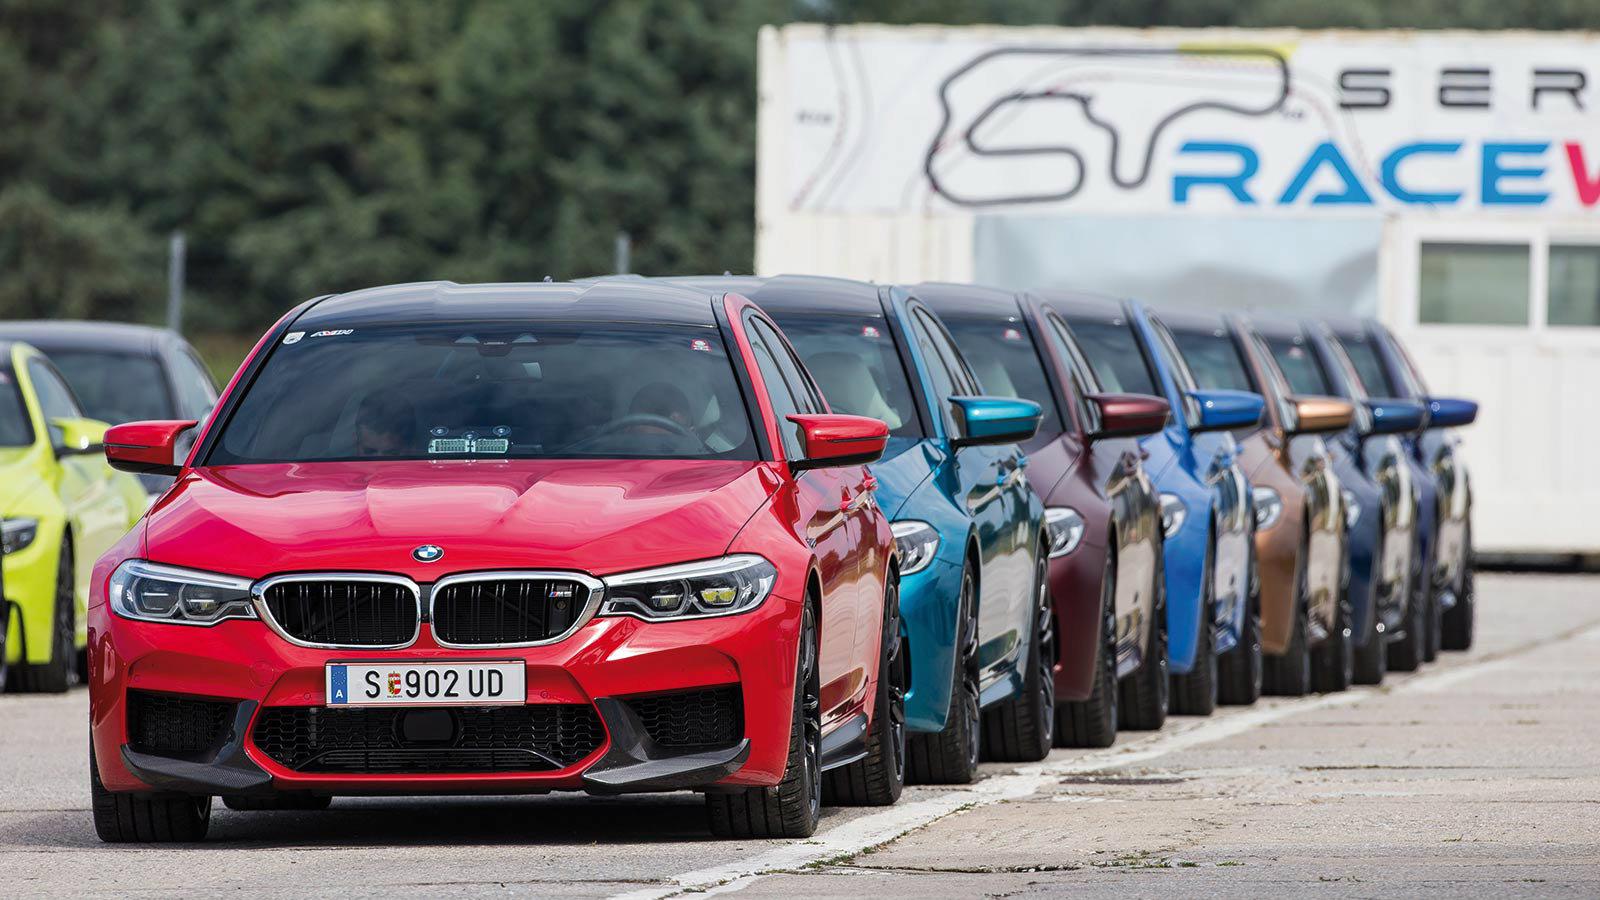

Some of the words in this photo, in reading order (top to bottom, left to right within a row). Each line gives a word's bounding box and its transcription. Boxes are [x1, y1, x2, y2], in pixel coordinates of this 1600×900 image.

[1337, 68, 1587, 110] SER
[335, 689, 344, 699] A
[365, 670, 381, 699] S
[405, 669, 459, 698] 902
[468, 669, 503, 697] UD
